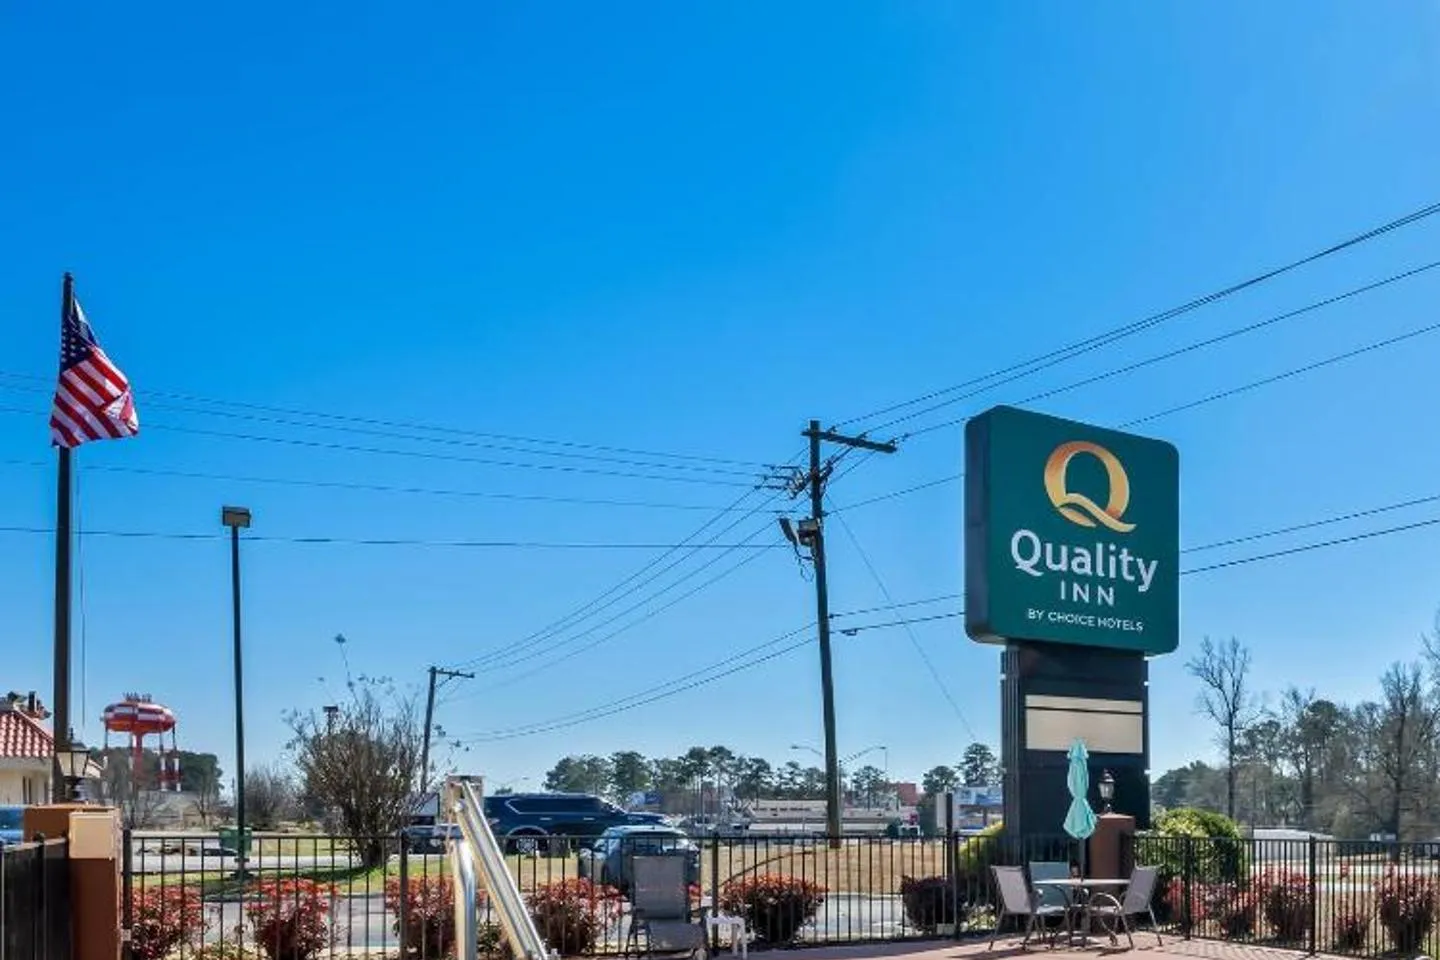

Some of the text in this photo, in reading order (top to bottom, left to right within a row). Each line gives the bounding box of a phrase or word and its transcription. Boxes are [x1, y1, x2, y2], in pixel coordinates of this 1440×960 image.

[1044, 441, 1137, 532] Q
[1011, 529, 1158, 592] Quality
[1061, 580, 1115, 606] INN
[1028, 608, 1143, 632] BY CHOICE HOTELS
